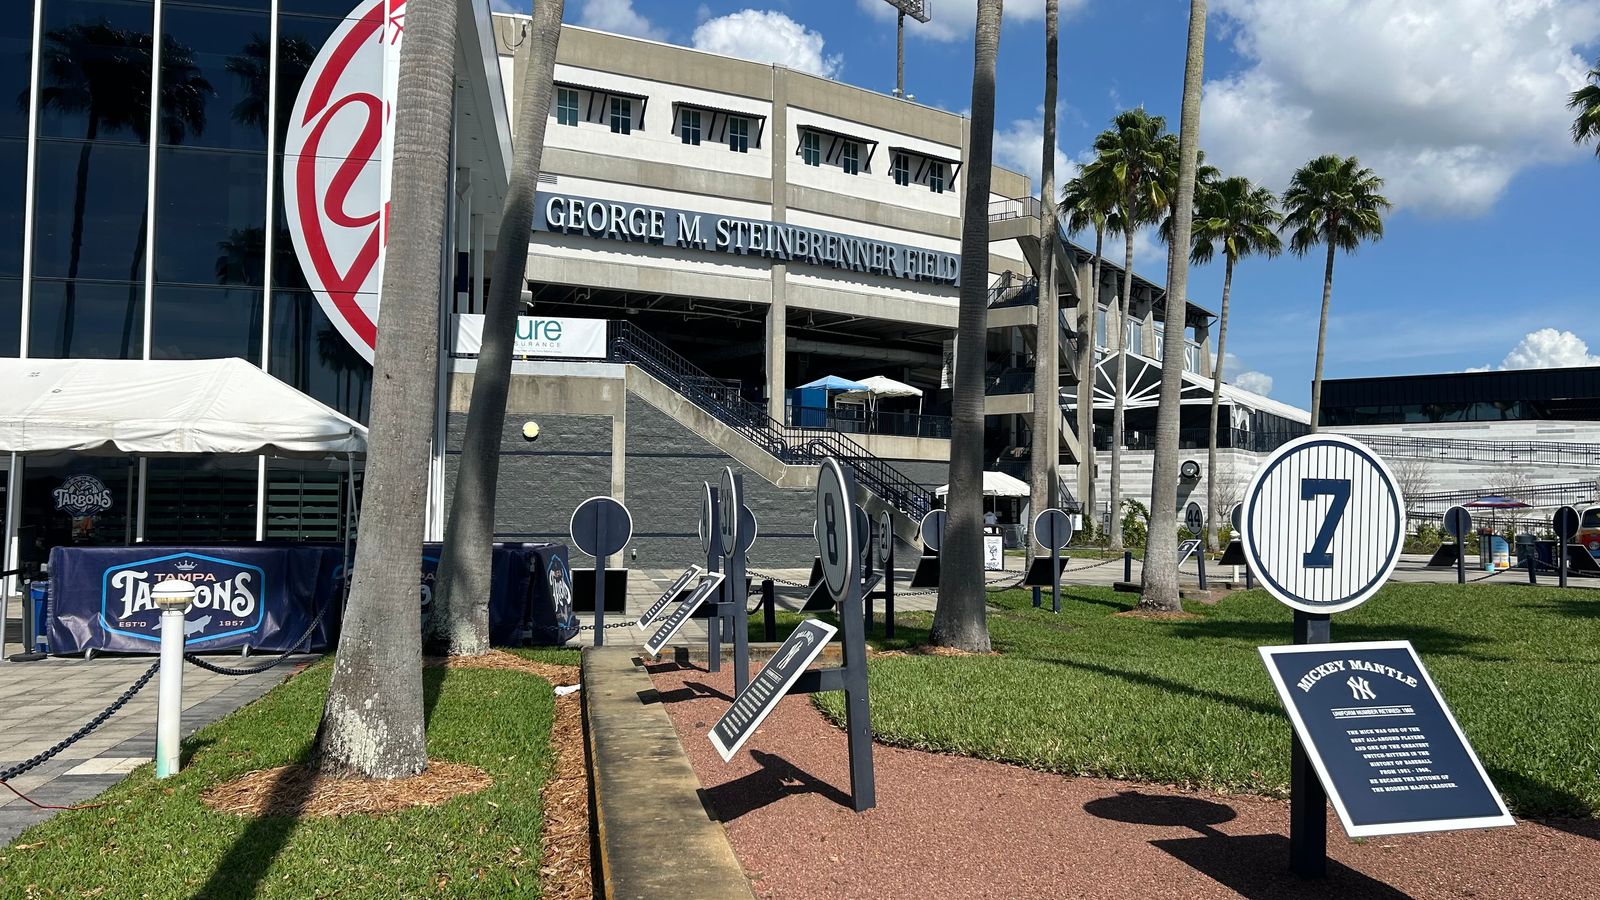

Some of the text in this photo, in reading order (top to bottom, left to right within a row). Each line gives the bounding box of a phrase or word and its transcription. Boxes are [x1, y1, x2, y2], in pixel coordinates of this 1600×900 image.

[546, 196, 961, 281] GEORGE M. STEINBRENNER FIELD
[824, 493, 838, 565] 8
[1188, 510, 1201, 527] 44
[1301, 478, 1352, 568] 7
[112, 570, 255, 619] TAONS
[154, 573, 217, 582] TAMPA
[1296, 660, 1418, 692] MICKEY MANTLE
